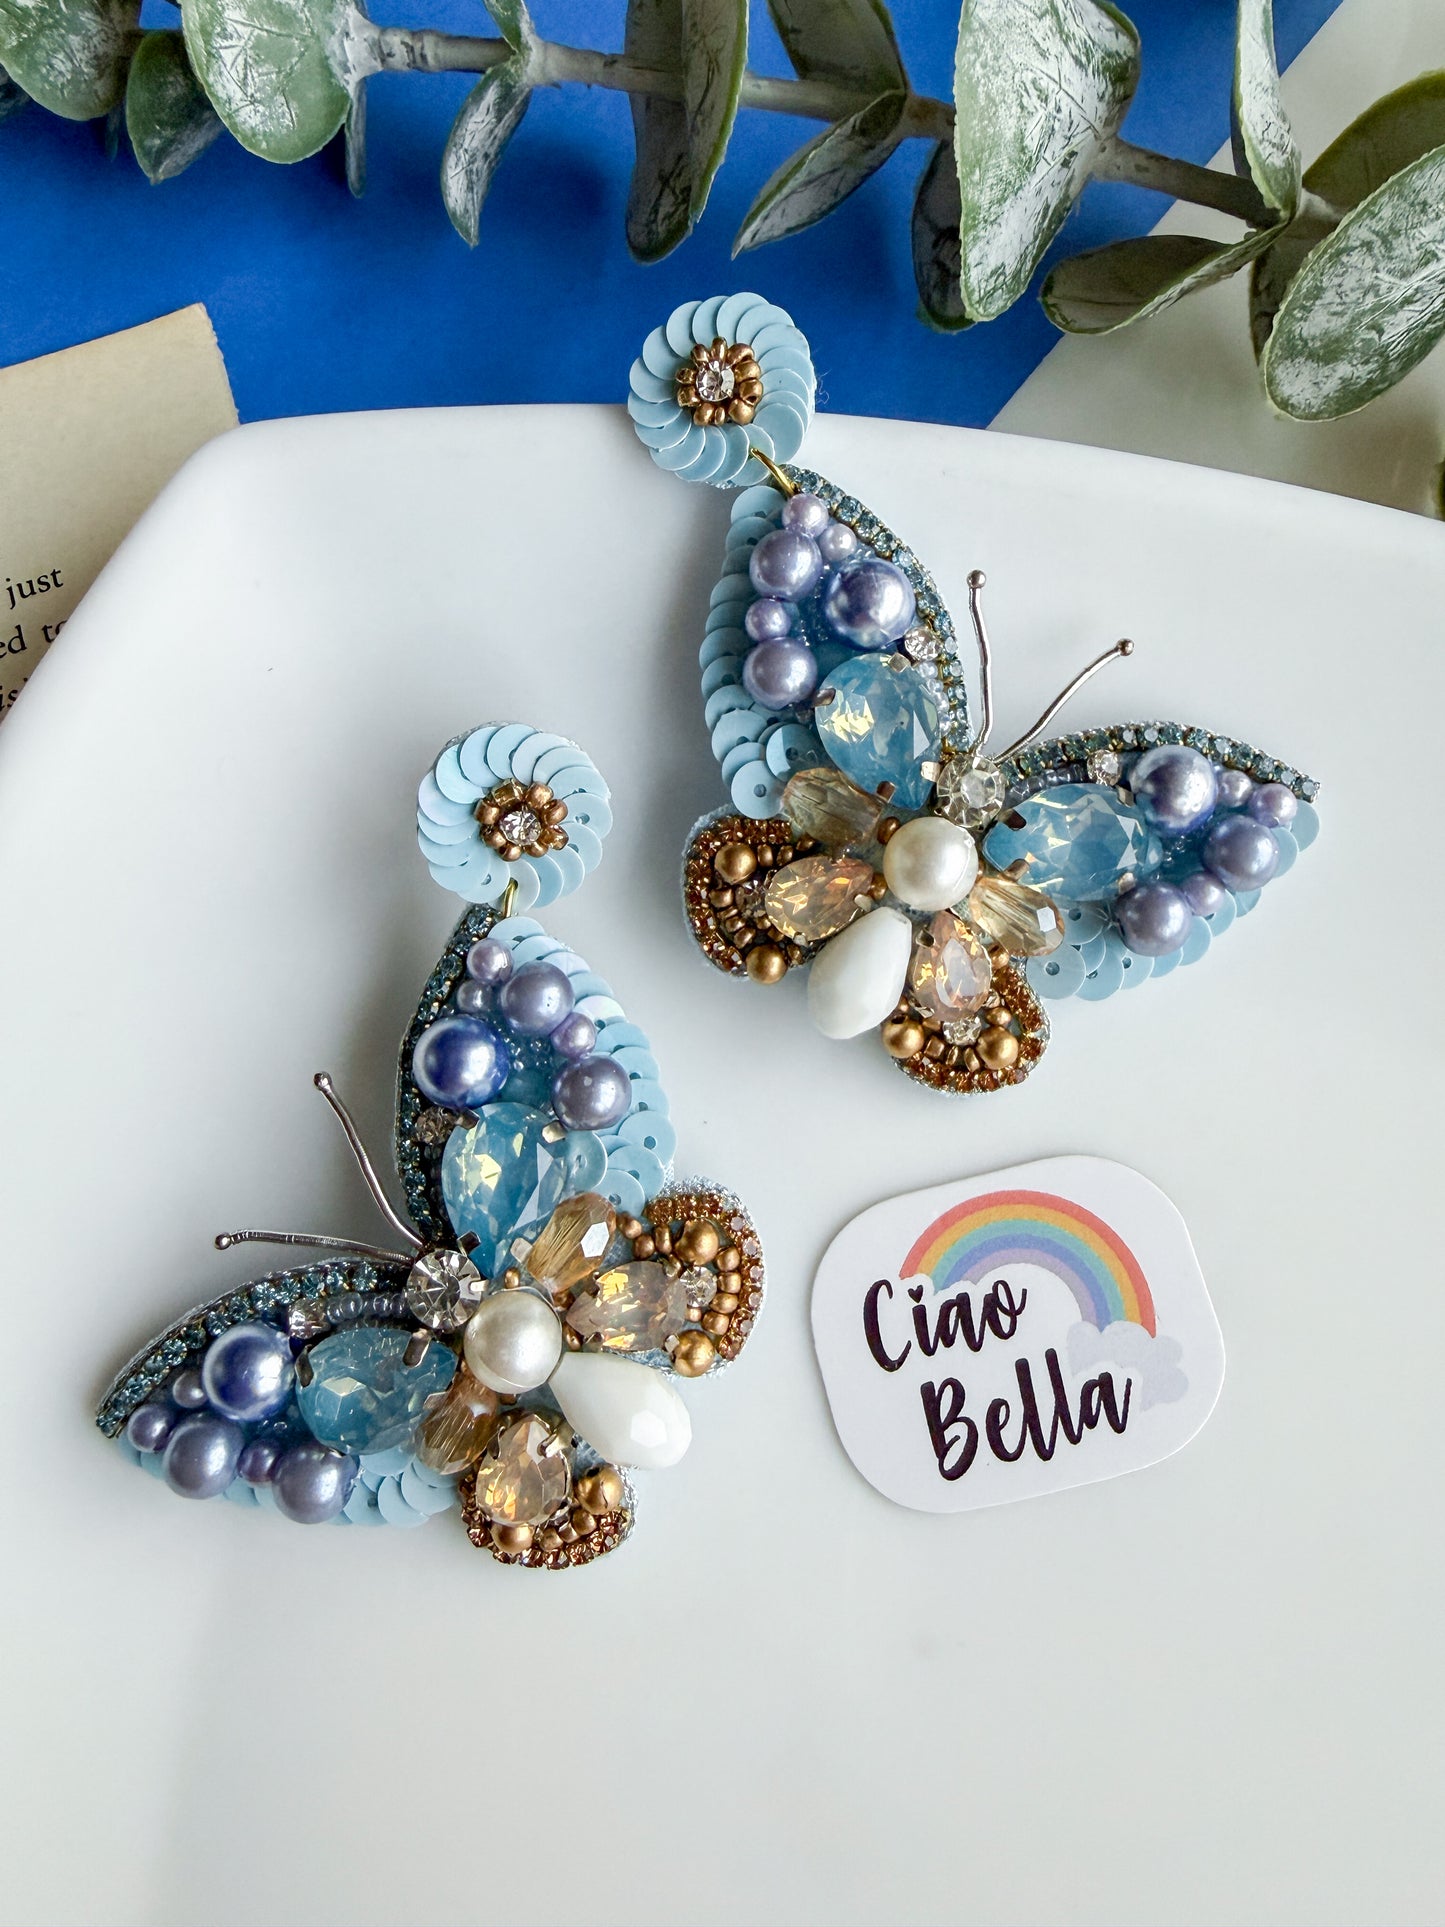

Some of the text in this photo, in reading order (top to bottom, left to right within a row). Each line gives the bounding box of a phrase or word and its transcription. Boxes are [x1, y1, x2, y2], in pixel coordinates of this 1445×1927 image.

[5, 568, 64, 610] just
[863, 1279, 1028, 1373] Ciao
[920, 1347, 1133, 1481] Bella
